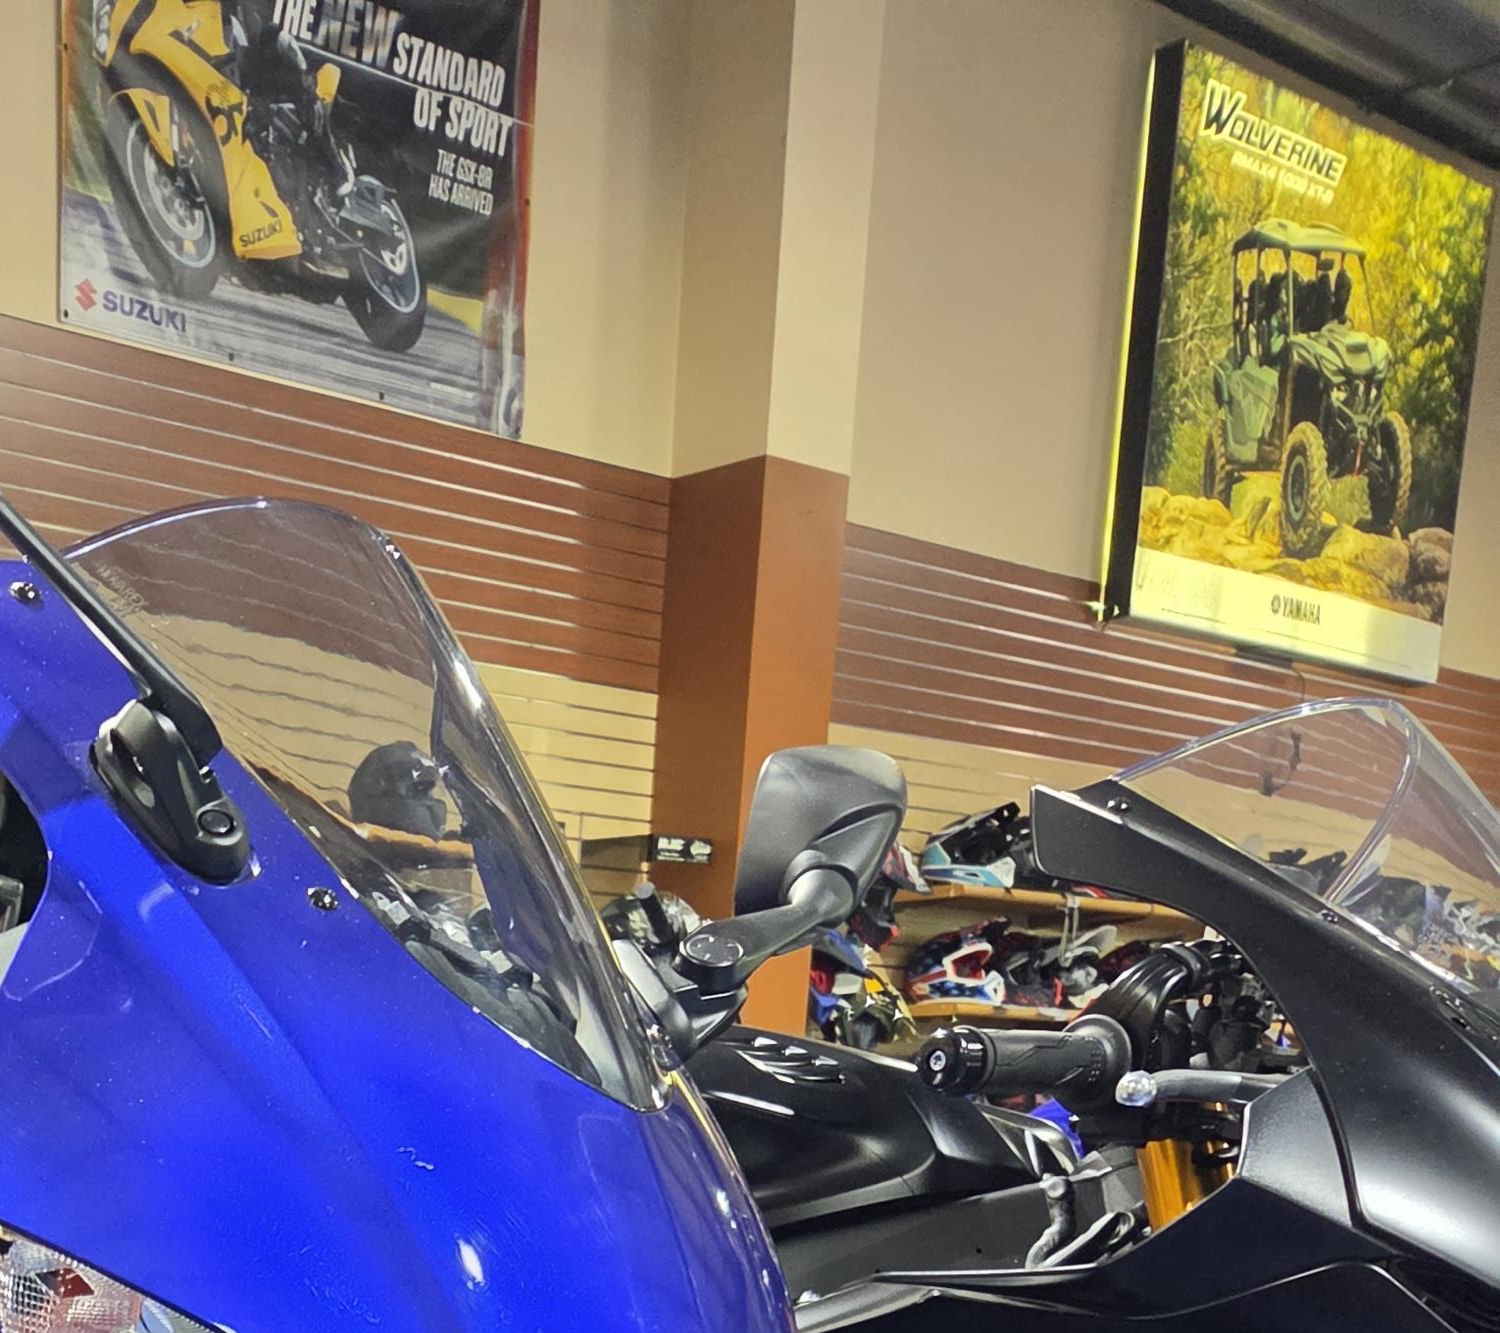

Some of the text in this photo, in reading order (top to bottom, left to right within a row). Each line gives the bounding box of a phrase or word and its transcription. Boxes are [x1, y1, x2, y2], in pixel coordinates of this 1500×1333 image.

[272, 0, 506, 108] THE NEW STANDARD
[412, 88, 513, 157] OF SPORT
[1202, 82, 1345, 184] WOLVERINE
[436, 149, 457, 177] THE
[428, 174, 494, 216] HAS ARRIVED
[239, 219, 283, 248] SUZUKI
[102, 290, 187, 333] SUZUKI
[1282, 596, 1321, 625] YAMAHA
